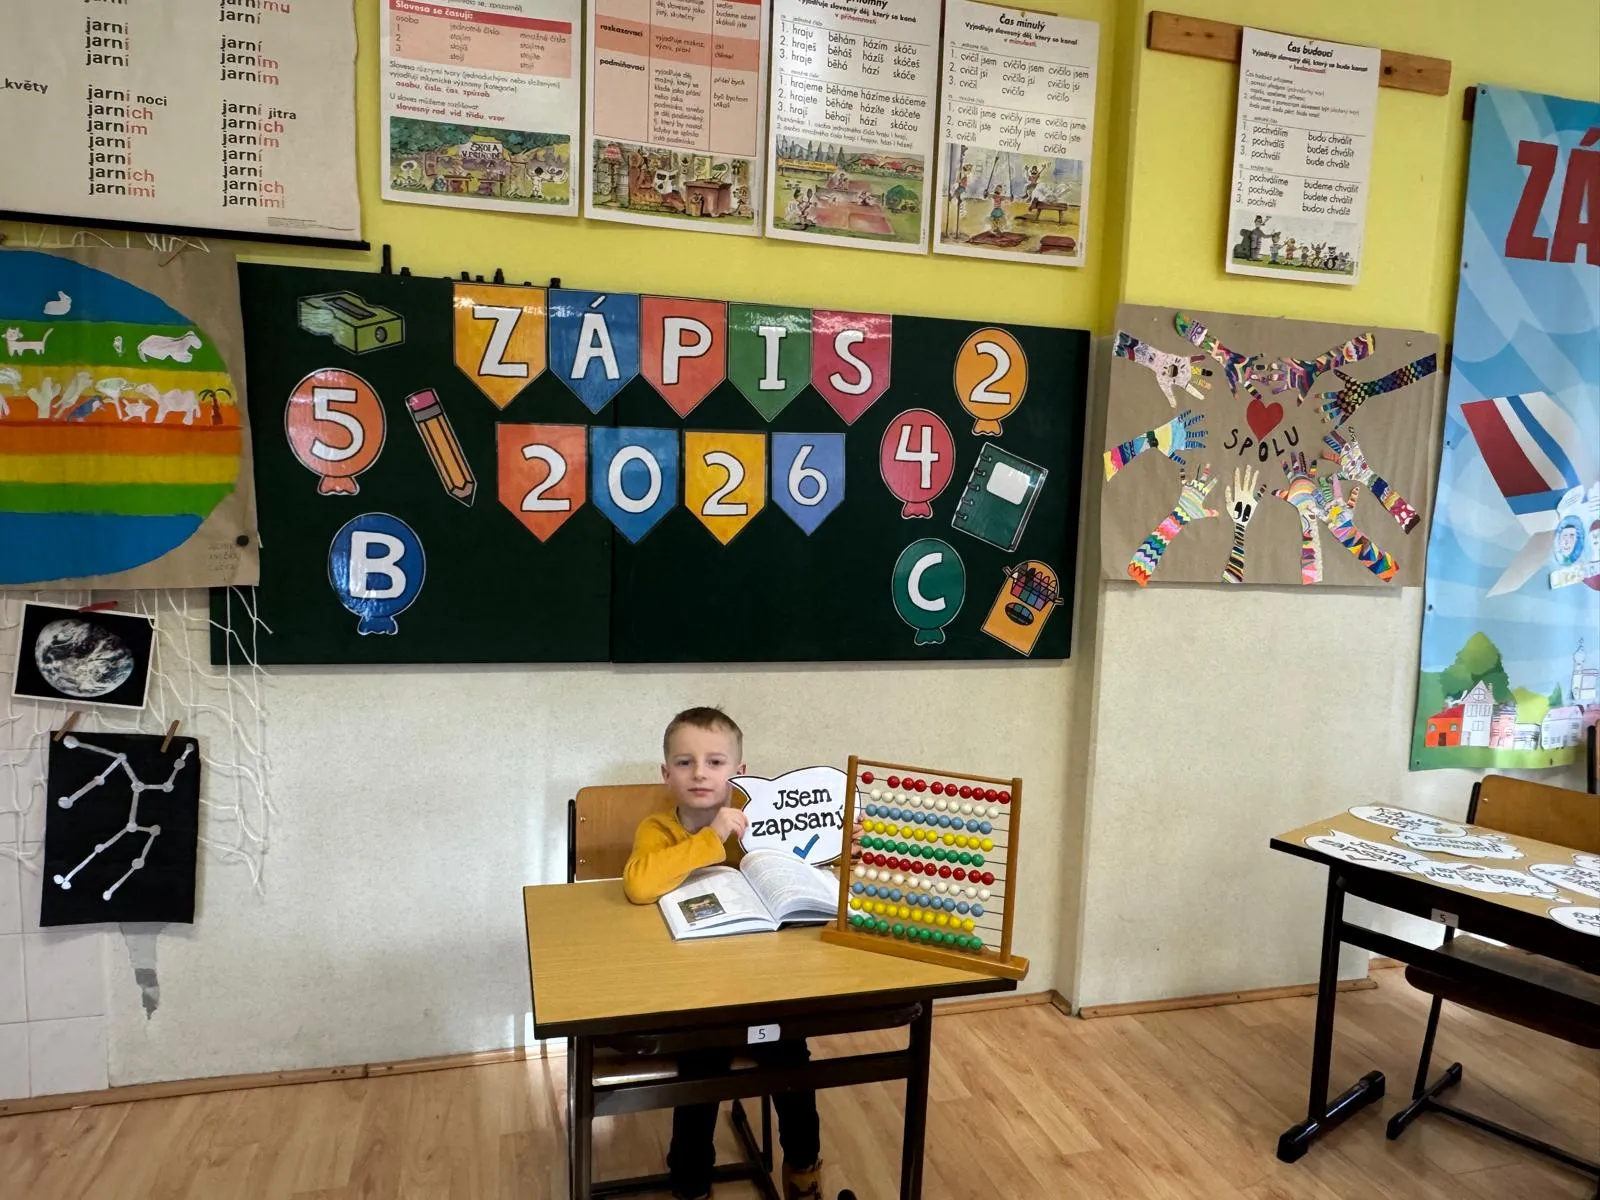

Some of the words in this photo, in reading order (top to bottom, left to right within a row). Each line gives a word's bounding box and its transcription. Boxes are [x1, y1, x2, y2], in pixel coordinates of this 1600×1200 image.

[999, 13, 1014, 26] Čas
[1016, 20, 1046, 32] minulý
[792, 24, 814, 39] hraju
[829, 31, 856, 46] běhám
[863, 38, 888, 51] házím
[894, 43, 917, 55] skáču
[1288, 41, 1301, 53] Čas
[792, 50, 812, 66] hraje
[828, 58, 848, 70] běhá
[862, 64, 880, 75] hází
[893, 69, 916, 81] skáče
[828, 44, 852, 58] běháš
[894, 57, 920, 68] skáčeš
[5, 78, 48, 94] květy
[136, 94, 168, 107] noci
[790, 90, 818, 106] hrajete
[791, 76, 823, 93] hrajeme
[827, 84, 858, 98] běháme
[892, 95, 926, 107] skáčeme
[267, 108, 297, 120] jitra
[472, 294, 873, 396] ZÁPIS
[969, 341, 1012, 405] 2
[310, 386, 365, 462] 5
[895, 424, 940, 489] 4
[1223, 426, 1299, 462] SPOLU
[520, 444, 828, 516] 2026
[350, 530, 407, 600] B
[907, 552, 946, 612] C
[773, 788, 832, 810] Jsem
[758, 1028, 766, 1040] 5
